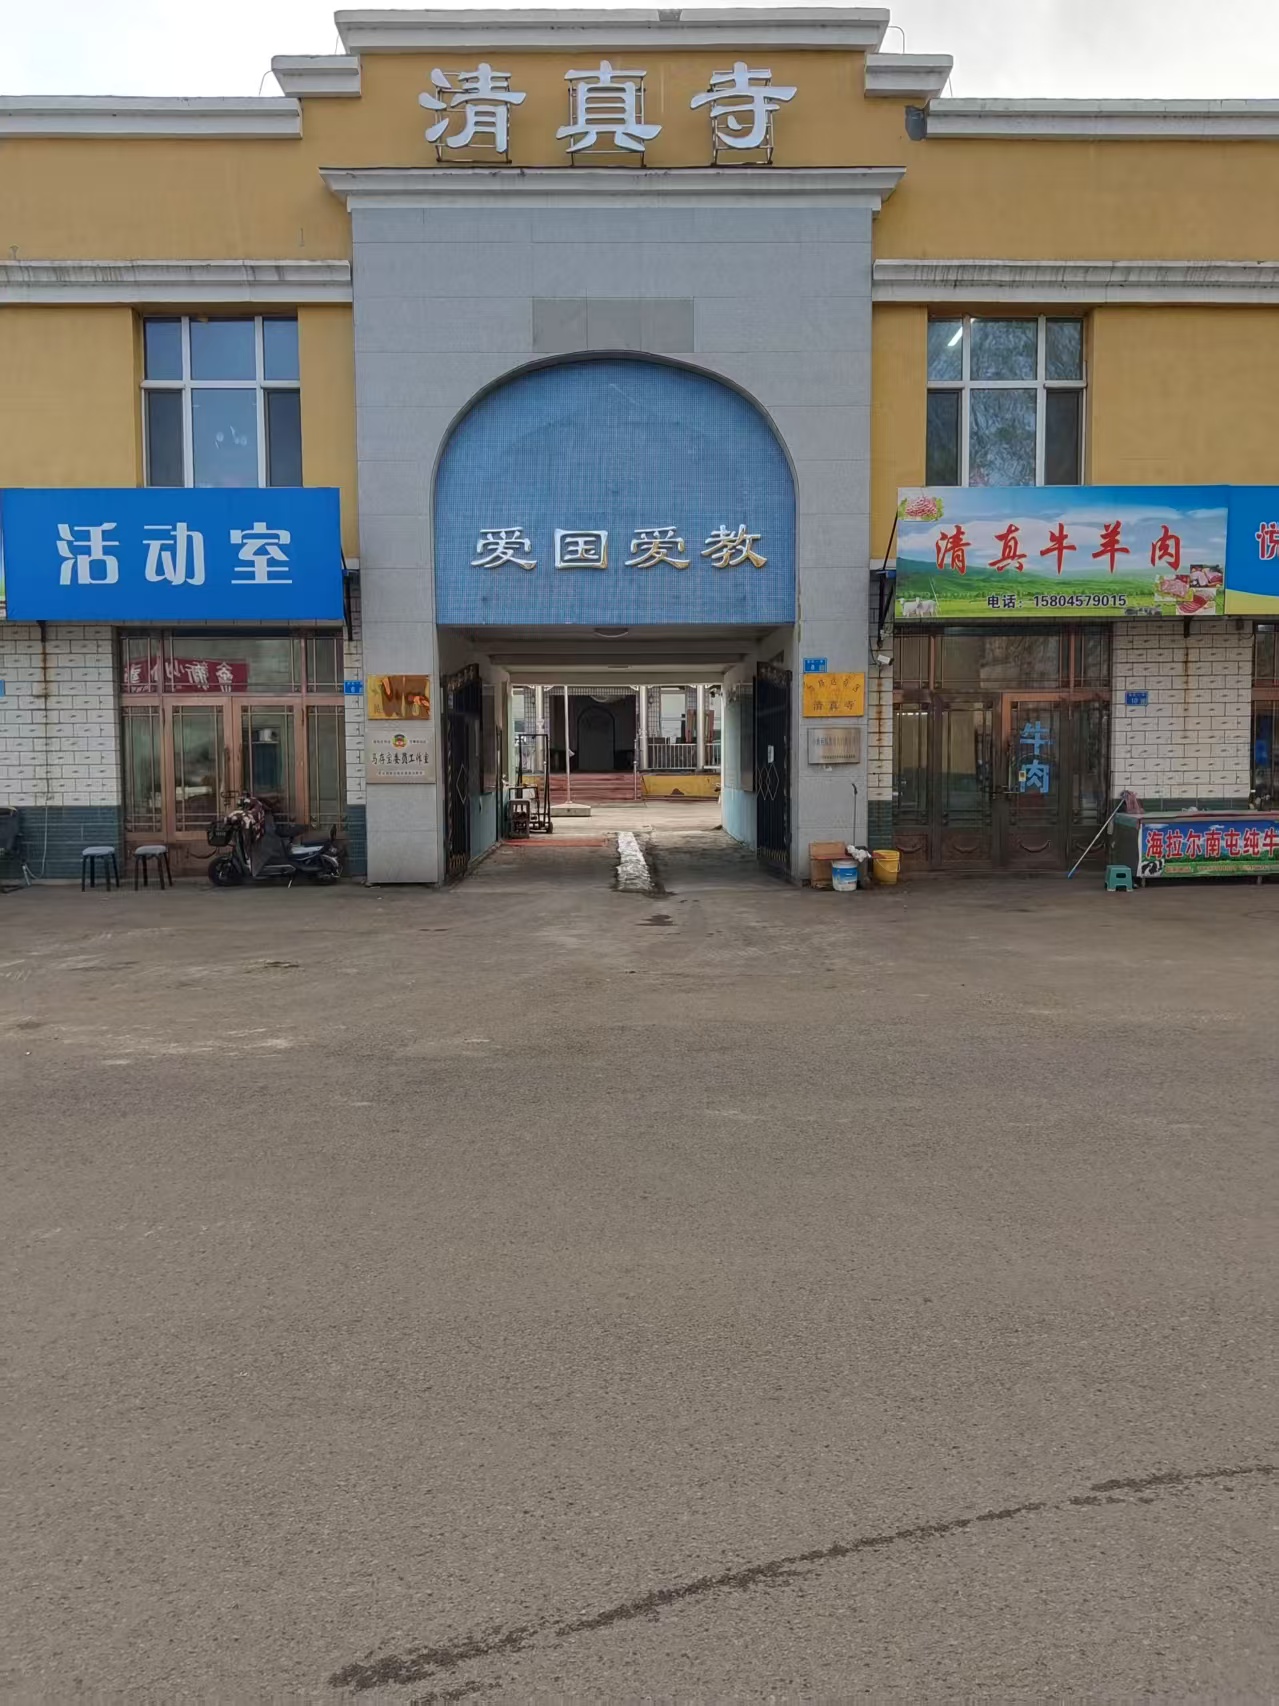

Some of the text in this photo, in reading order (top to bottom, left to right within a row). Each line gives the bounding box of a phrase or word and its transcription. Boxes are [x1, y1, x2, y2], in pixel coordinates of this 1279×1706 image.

[418, 59, 798, 154] 清真寺
[56, 521, 294, 586] 活动室
[470, 523, 768, 571] 爱国爱教
[934, 519, 1183, 575] 清真牛羊肉
[1020, 722, 1051, 793] 牛肉
[1146, 827, 1279, 860] 海拉尔南屯纯牛
